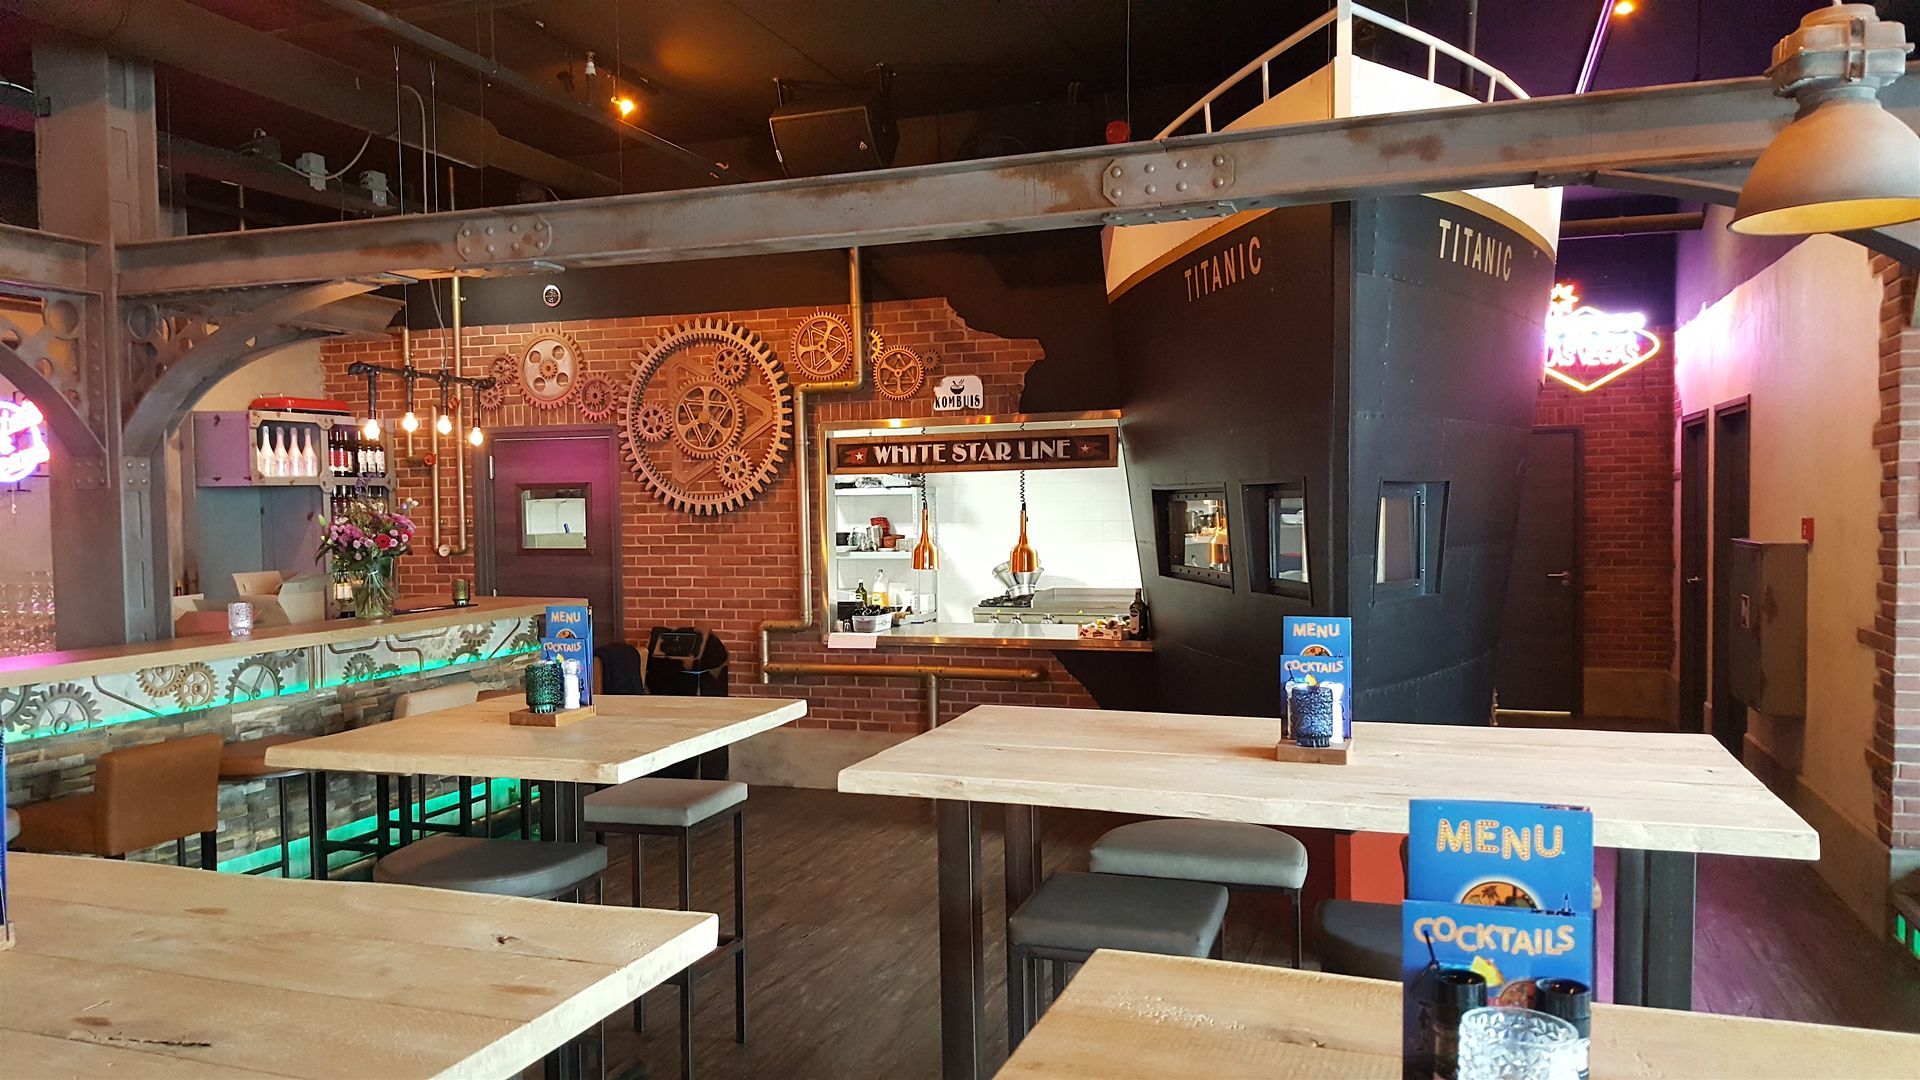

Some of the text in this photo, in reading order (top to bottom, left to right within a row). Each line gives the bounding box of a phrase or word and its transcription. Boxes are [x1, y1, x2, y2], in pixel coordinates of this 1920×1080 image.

[1440, 218, 1512, 281] TITANIC
[1184, 236, 1261, 302] TITANIC
[935, 394, 980, 408] KOMBUIS
[874, 439, 1071, 464] WHITE STAR LINE
[551, 610, 581, 624] MENU
[1293, 622, 1341, 639] MENU
[543, 641, 582, 653] COCKTAILS
[1284, 659, 1344, 674] COCKTAILS
[1436, 818, 1564, 861] MENU
[1413, 916, 1576, 956] COCKTAILS
